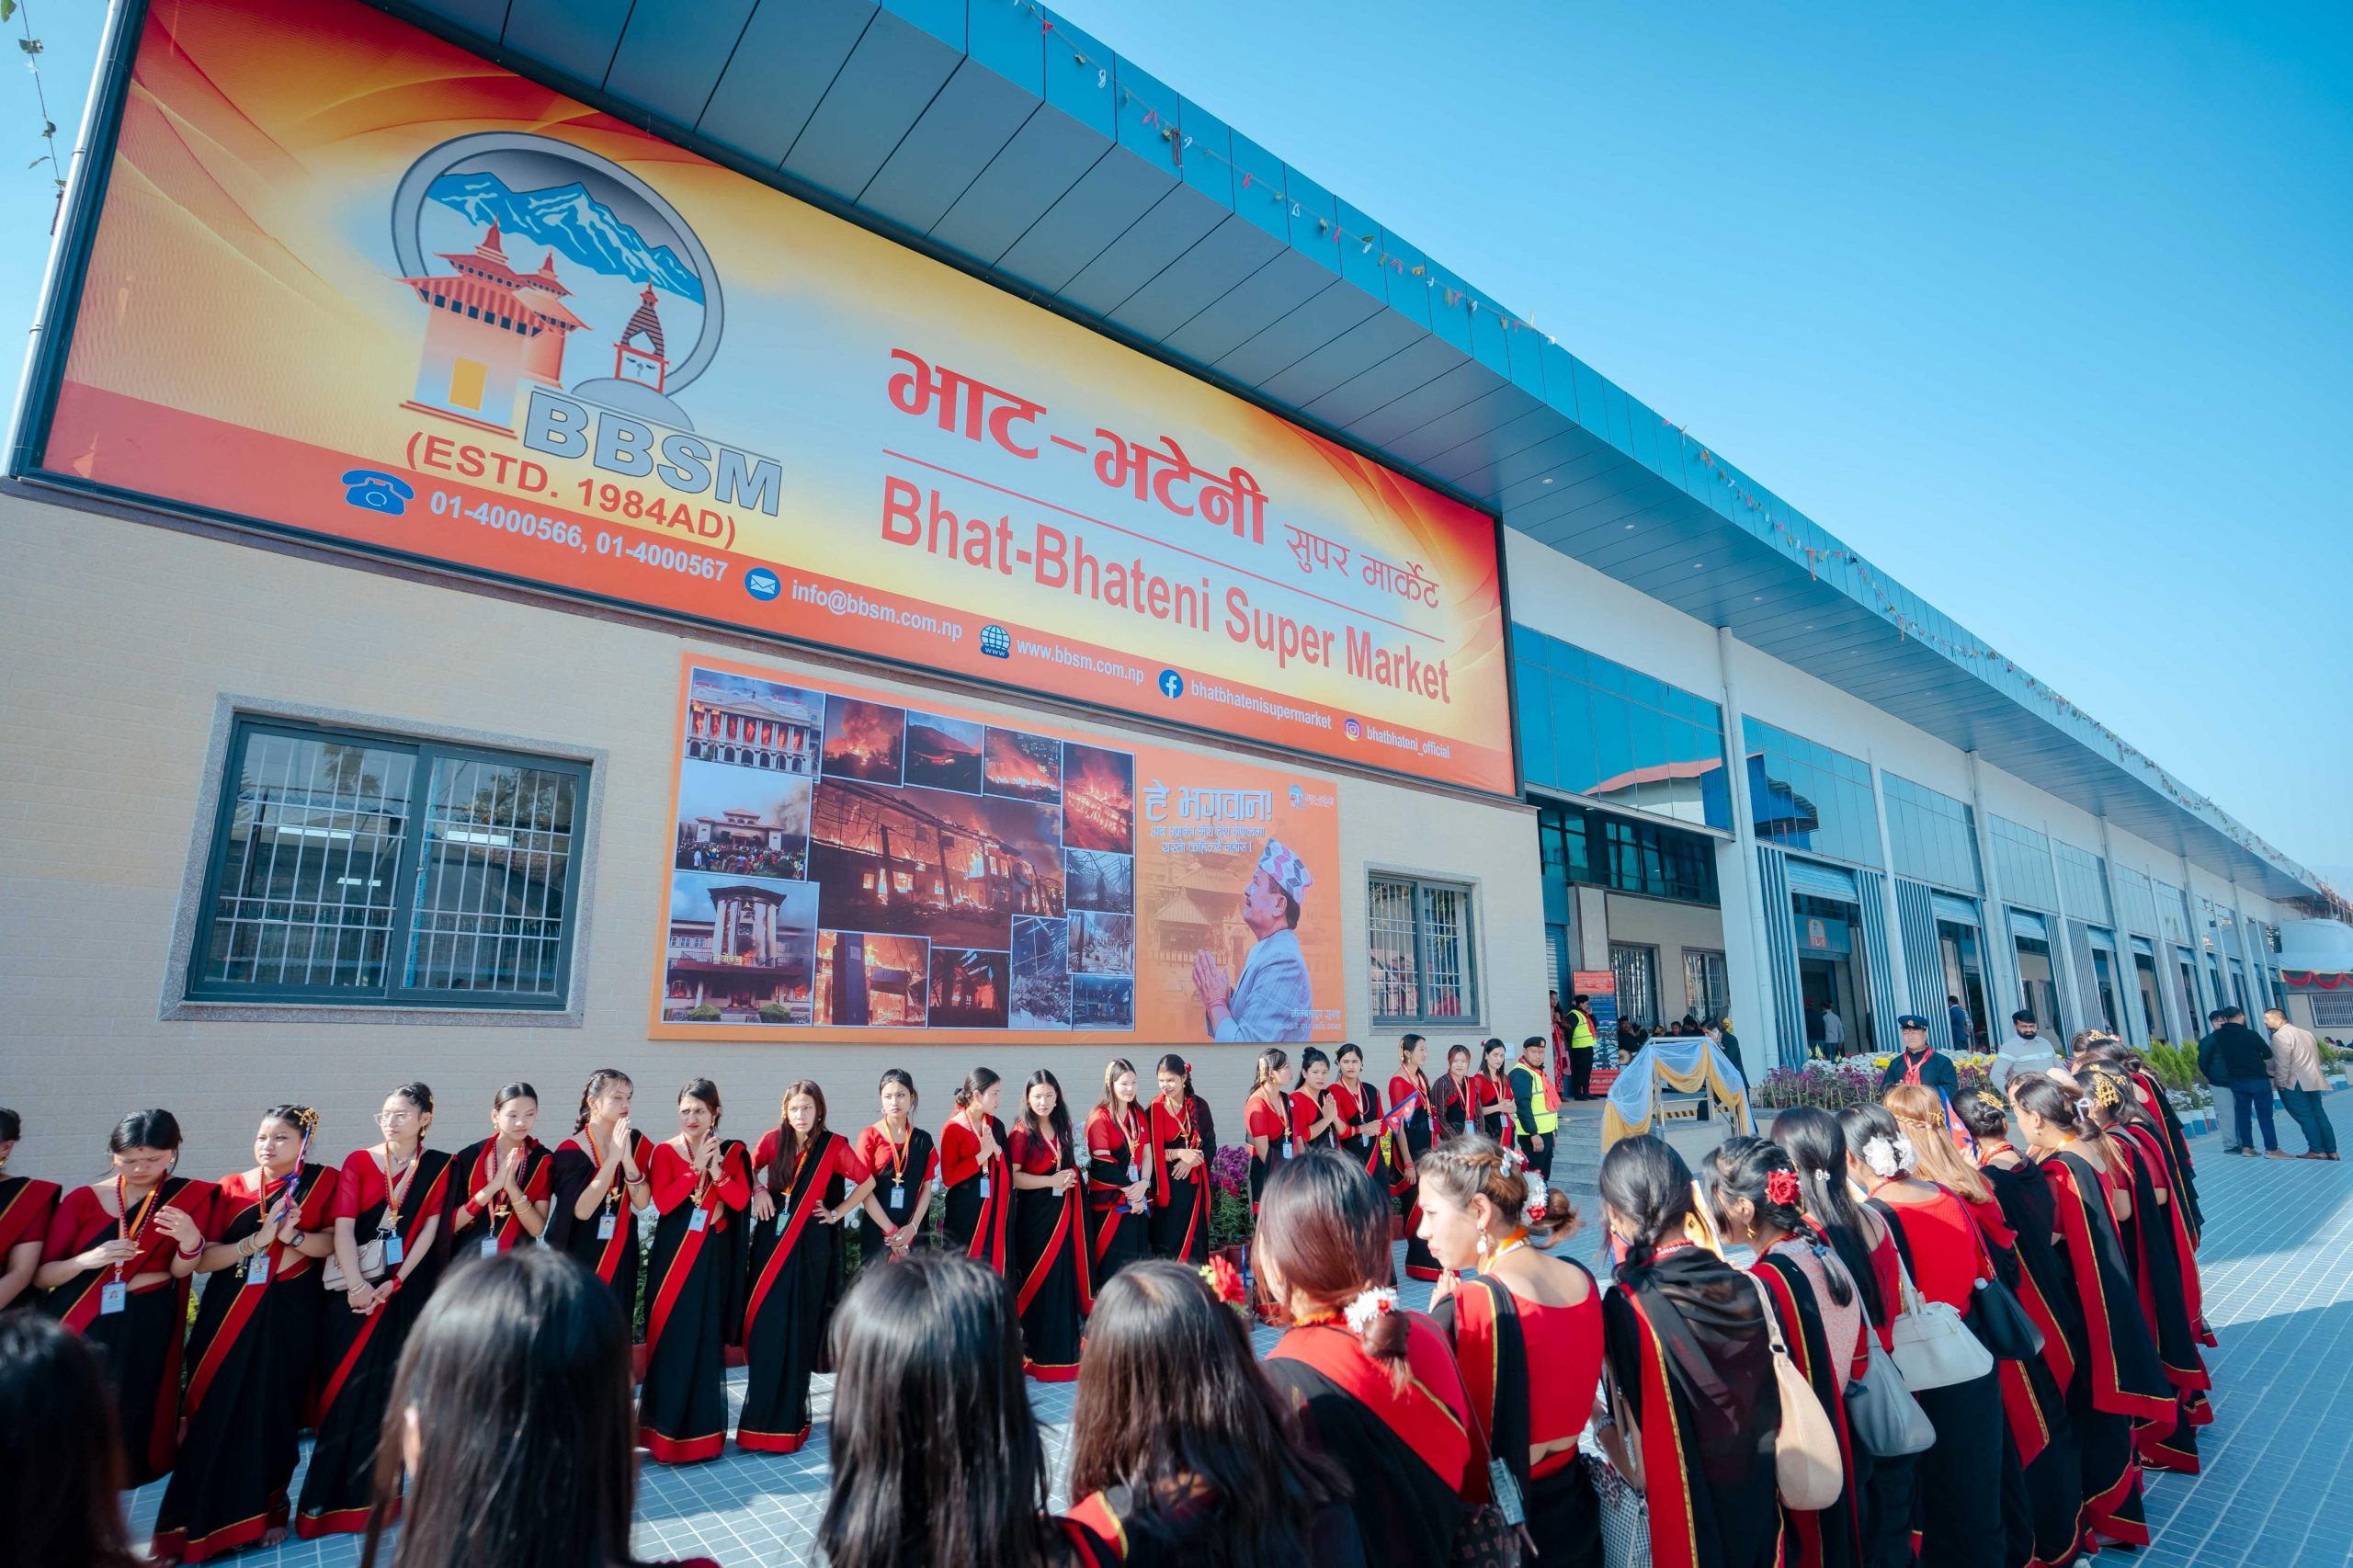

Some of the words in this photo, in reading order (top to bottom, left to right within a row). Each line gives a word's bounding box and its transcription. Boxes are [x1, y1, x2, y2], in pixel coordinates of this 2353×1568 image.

[406, 431, 559, 499] (ESTD.
[577, 478, 737, 551] 1984AD)
[523, 390, 783, 517] BBSM
[430, 491, 588, 552] 01-4000566,
[597, 532, 729, 582] 01-4000567
[1282, 521, 1350, 576] सुपर
[1359, 551, 1440, 609] मार्केट
[791, 579, 963, 642] info@bbsm.com.np
[881, 474, 1211, 632] Bhat-Bhateni
[1224, 586, 1336, 669] Super
[1346, 625, 1450, 704] Market
[1017, 637, 1144, 686] www.bbsm.com.np
[1190, 679, 1332, 730] bhatbhatenisupermarket
[1367, 725, 1450, 759] bhatbhateni_official
[1142, 778, 1170, 822] हे
[1178, 786, 1273, 823] भगवान!
